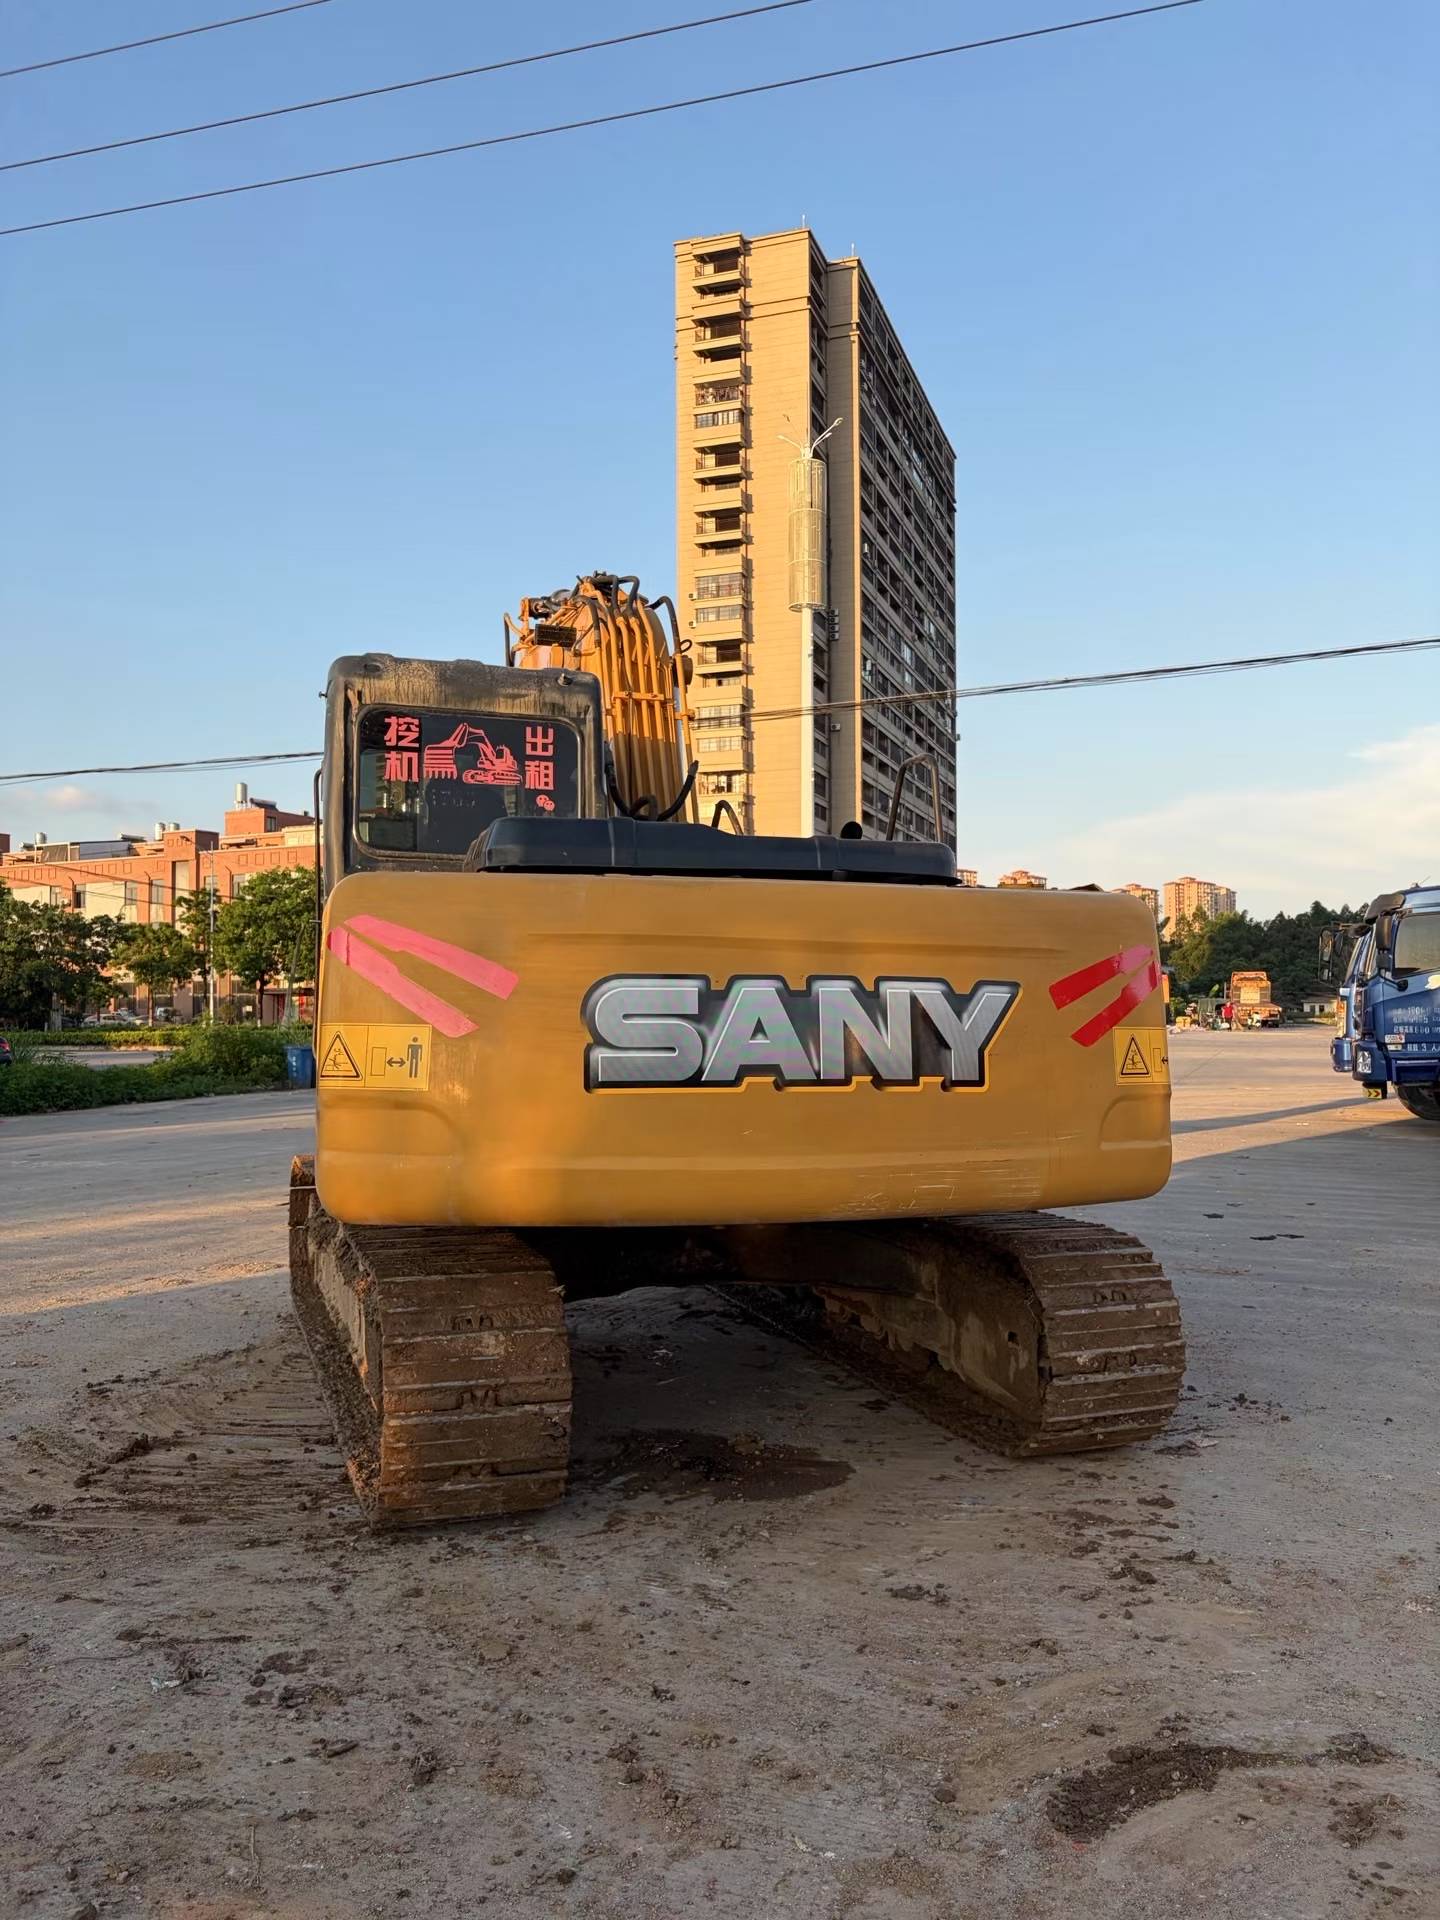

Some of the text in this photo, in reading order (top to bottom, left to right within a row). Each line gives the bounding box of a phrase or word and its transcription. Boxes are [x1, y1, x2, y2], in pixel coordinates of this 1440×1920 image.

[384, 715, 420, 783] 挖机
[525, 726, 555, 791] 出租
[584, 976, 1017, 1088] SANY
